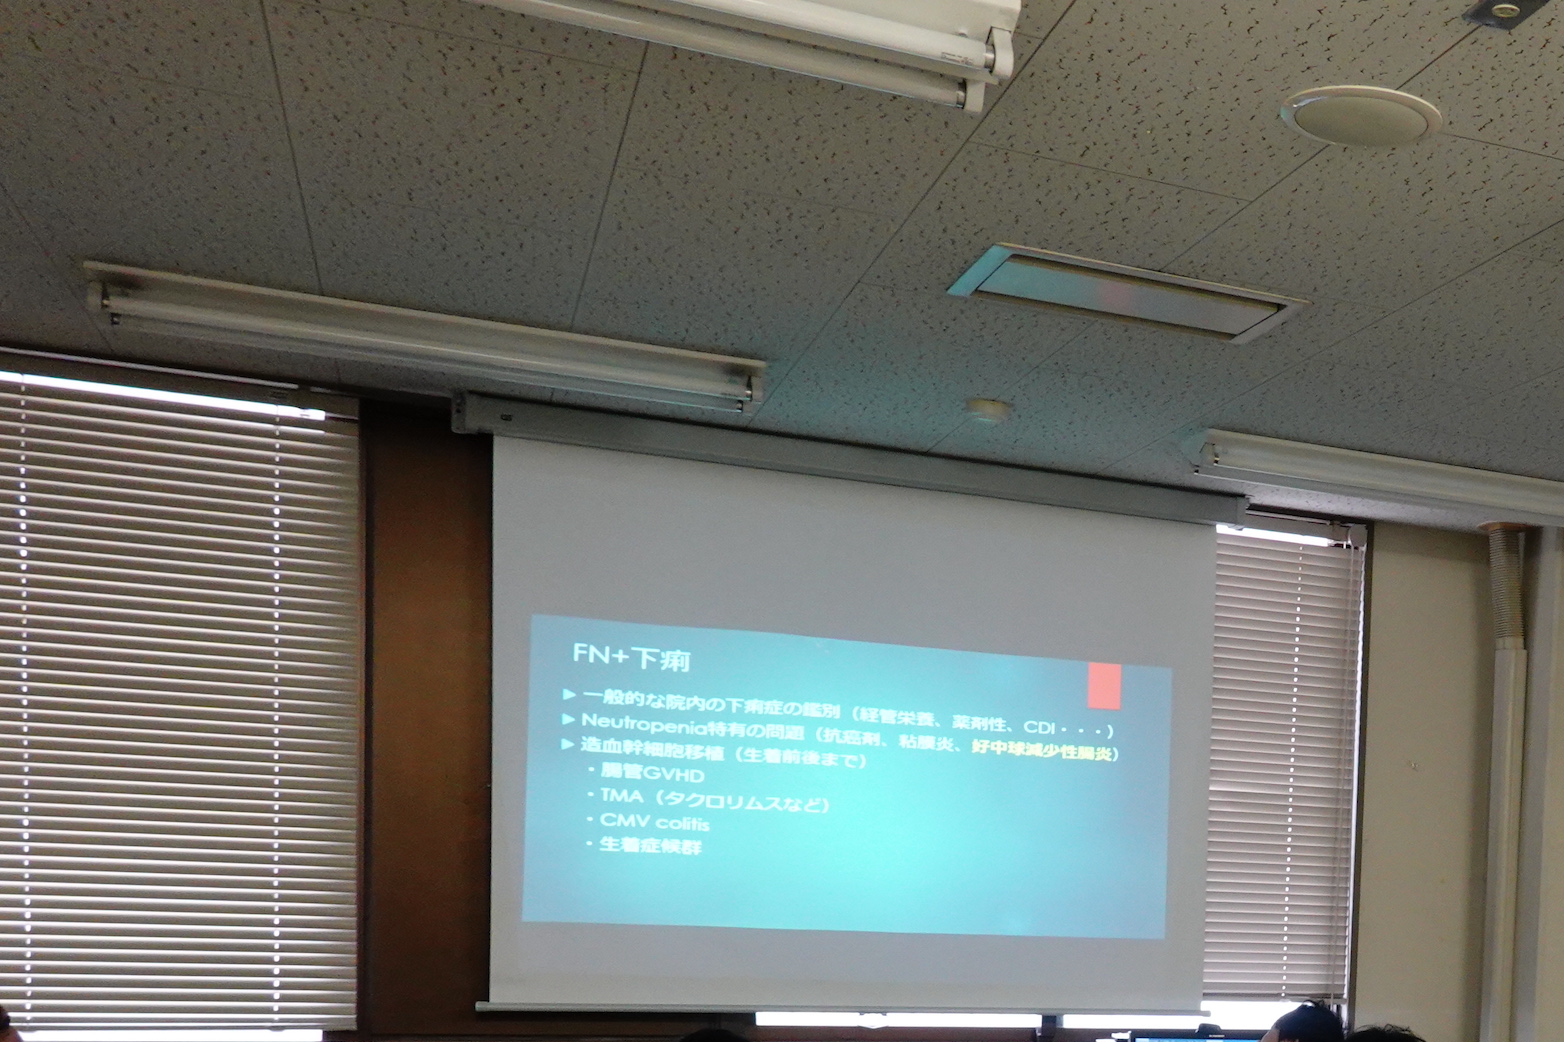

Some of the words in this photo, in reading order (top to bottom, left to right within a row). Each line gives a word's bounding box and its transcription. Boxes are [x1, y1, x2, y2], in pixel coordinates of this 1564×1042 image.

[573, 642, 692, 673] FN+下痢
[600, 812, 651, 828] CMV
[655, 816, 710, 832] colitis
[599, 836, 703, 856] 生着症候群
